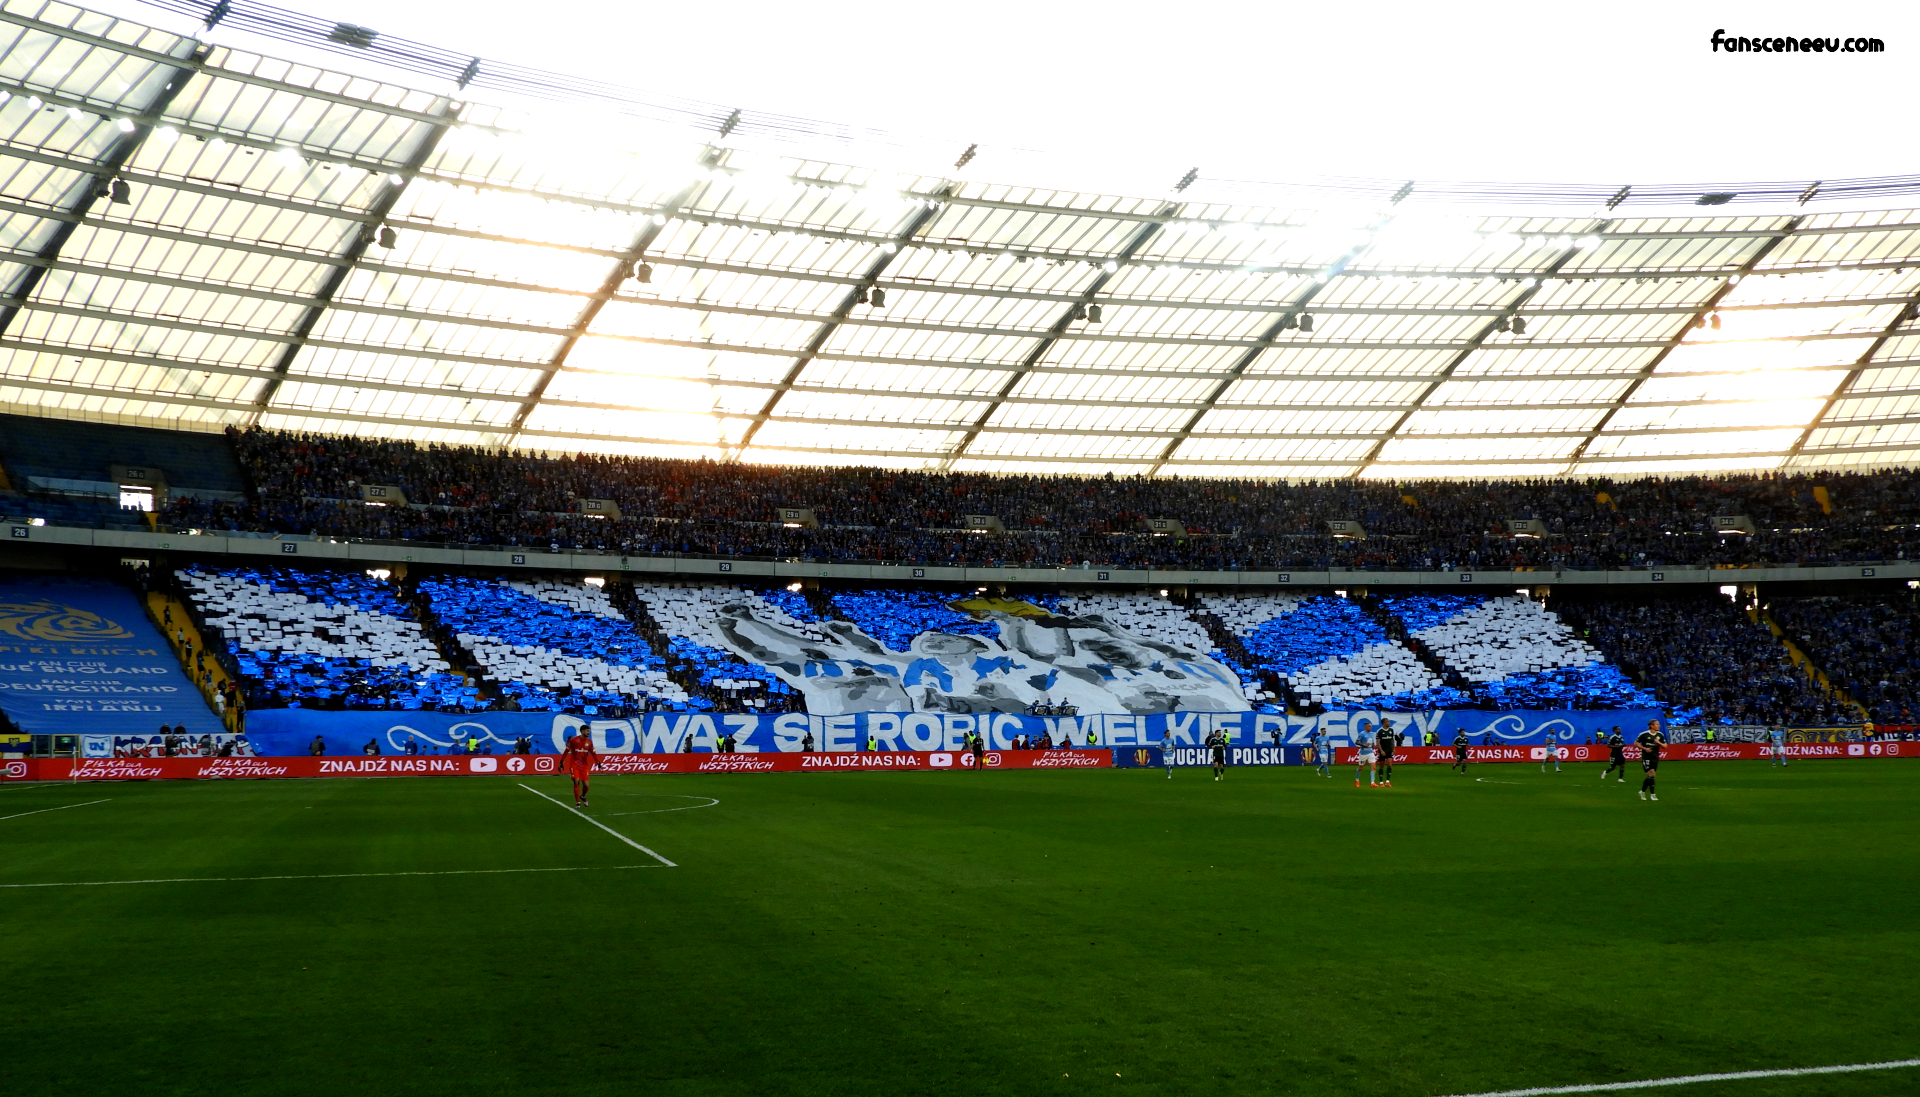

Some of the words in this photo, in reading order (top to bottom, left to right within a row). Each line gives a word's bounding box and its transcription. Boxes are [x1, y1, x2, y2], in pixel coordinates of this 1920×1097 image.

[14, 528, 26, 537] 26
[284, 544, 295, 553] 27
[514, 556, 523, 564] 28
[914, 569, 923, 577] 30
[1099, 572, 1108, 580] 31
[1461, 574, 1470, 582] 33
[41, 666, 168, 674] ENGLAND
[1042, 712, 1242, 746] WIELKIE
[1477, 749, 1502, 759] NAS
[1504, 749, 1524, 759] NA:
[1801, 746, 1823, 755] NAS
[1824, 746, 1843, 755] NA:
[802, 752, 859, 767] ZNAJDŹ
[862, 755, 893, 766] NAS
[899, 755, 921, 766] NA:
[1173, 748, 1226, 765] UCHA
[1233, 747, 1285, 764] POLSKI
[319, 757, 387, 772] ZNAJDŹ
[390, 759, 426, 772] NAS
[430, 759, 460, 771] NA:
[698, 762, 775, 770] WSZYSTKICH
[1032, 758, 1100, 766] WSZYSTKICH
[197, 766, 288, 776] WSZYSTKICH
[590, 762, 669, 772] WSZYSTKICH
[68, 767, 162, 778] WSZYSTKICH
